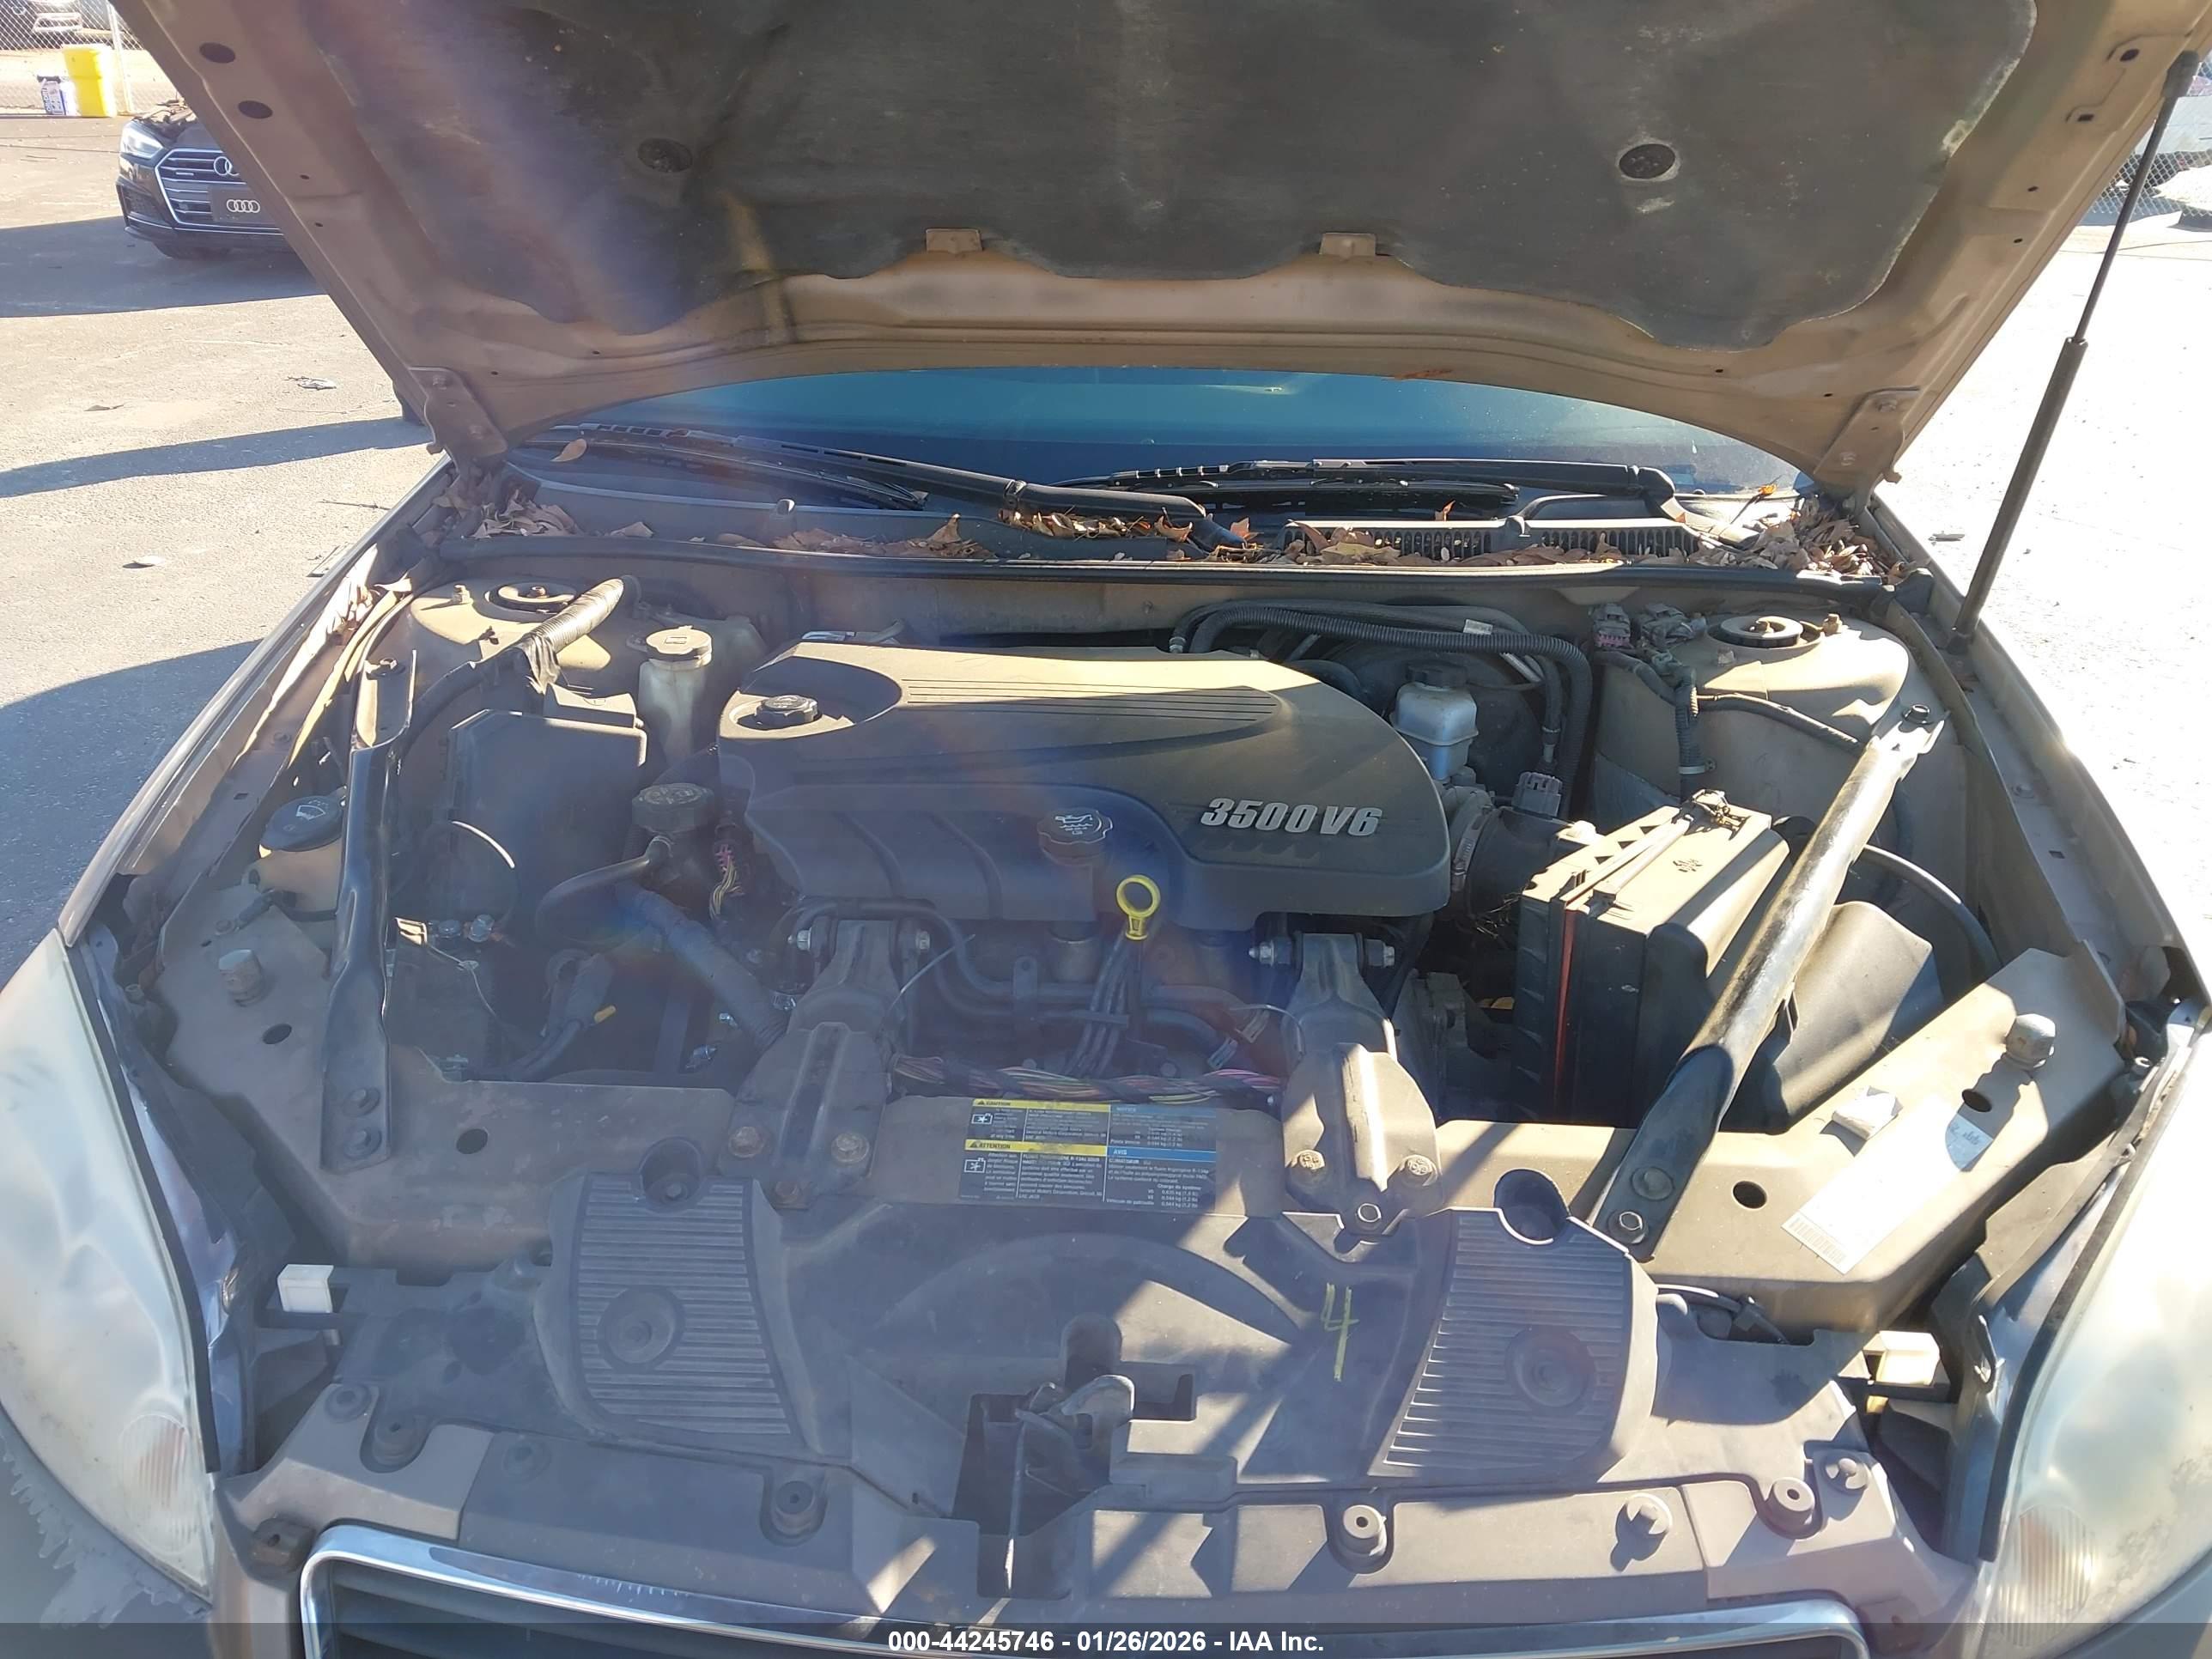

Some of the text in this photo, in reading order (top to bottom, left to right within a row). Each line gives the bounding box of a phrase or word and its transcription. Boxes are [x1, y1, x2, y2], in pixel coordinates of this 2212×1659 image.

[1200, 798, 1382, 836] 3500 V6
[1320, 1282, 1360, 1382] 4
